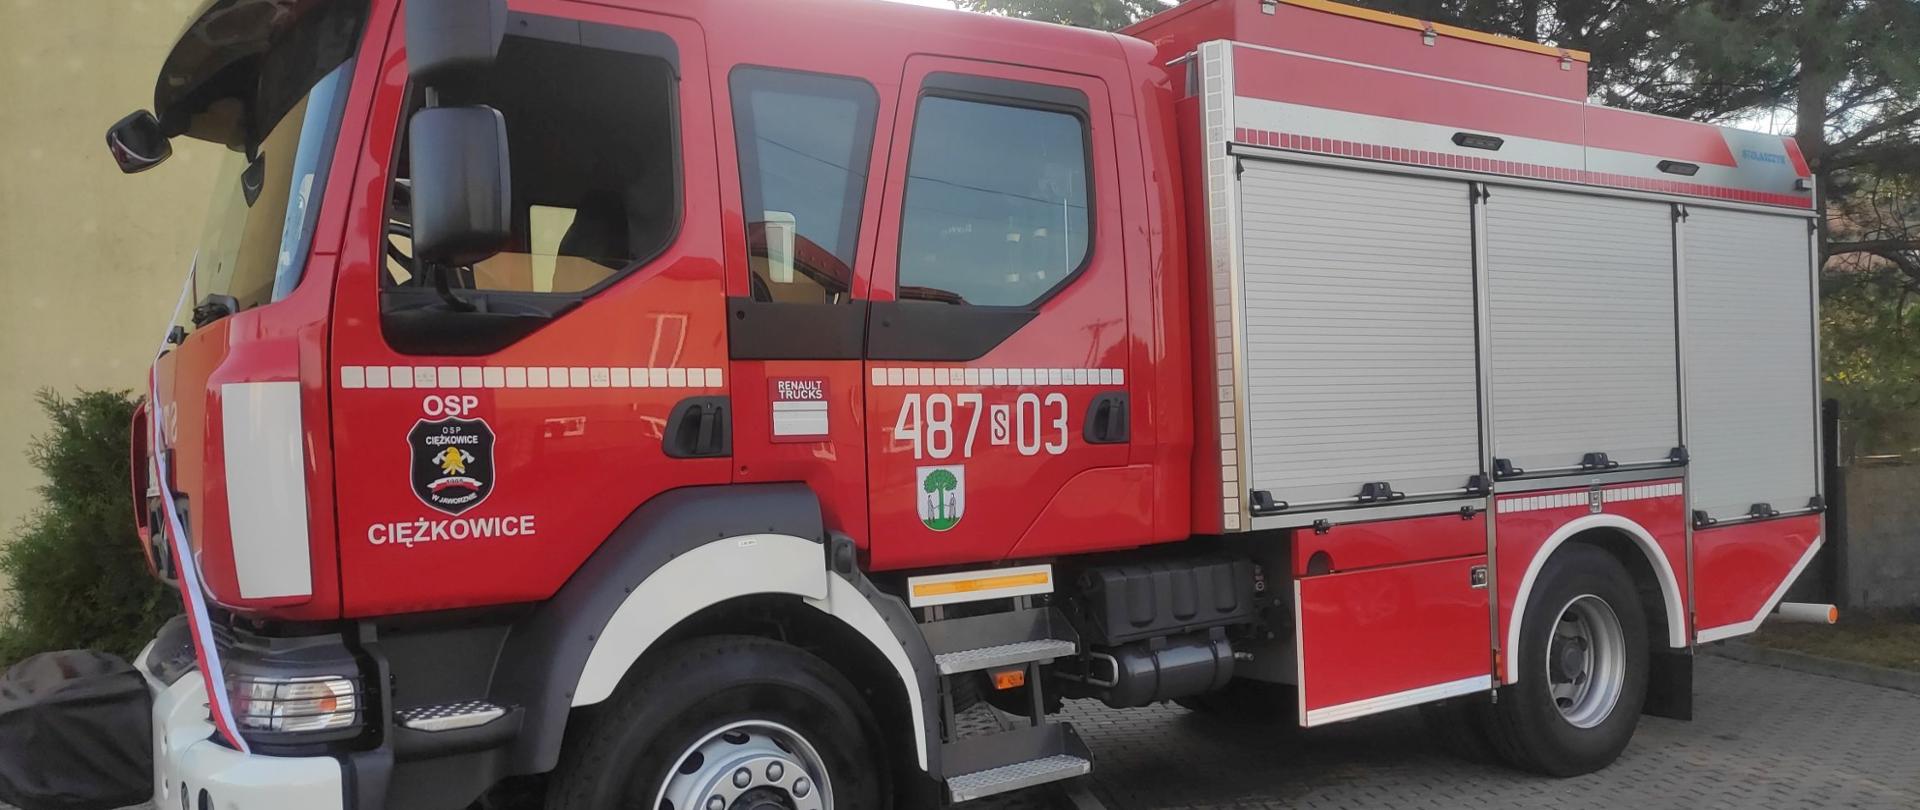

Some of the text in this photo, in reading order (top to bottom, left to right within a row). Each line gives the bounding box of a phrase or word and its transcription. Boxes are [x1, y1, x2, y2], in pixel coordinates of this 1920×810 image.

[778, 381, 822, 390] RENAULT
[779, 390, 823, 399] TRUCKS
[423, 395, 479, 417] OSP
[894, 392, 1069, 460] 487 S 03
[425, 434, 479, 446] CIĘŻKOWICE
[431, 491, 478, 504] W JAWORZNIE
[367, 515, 536, 548] CIĘŻKOWICE
